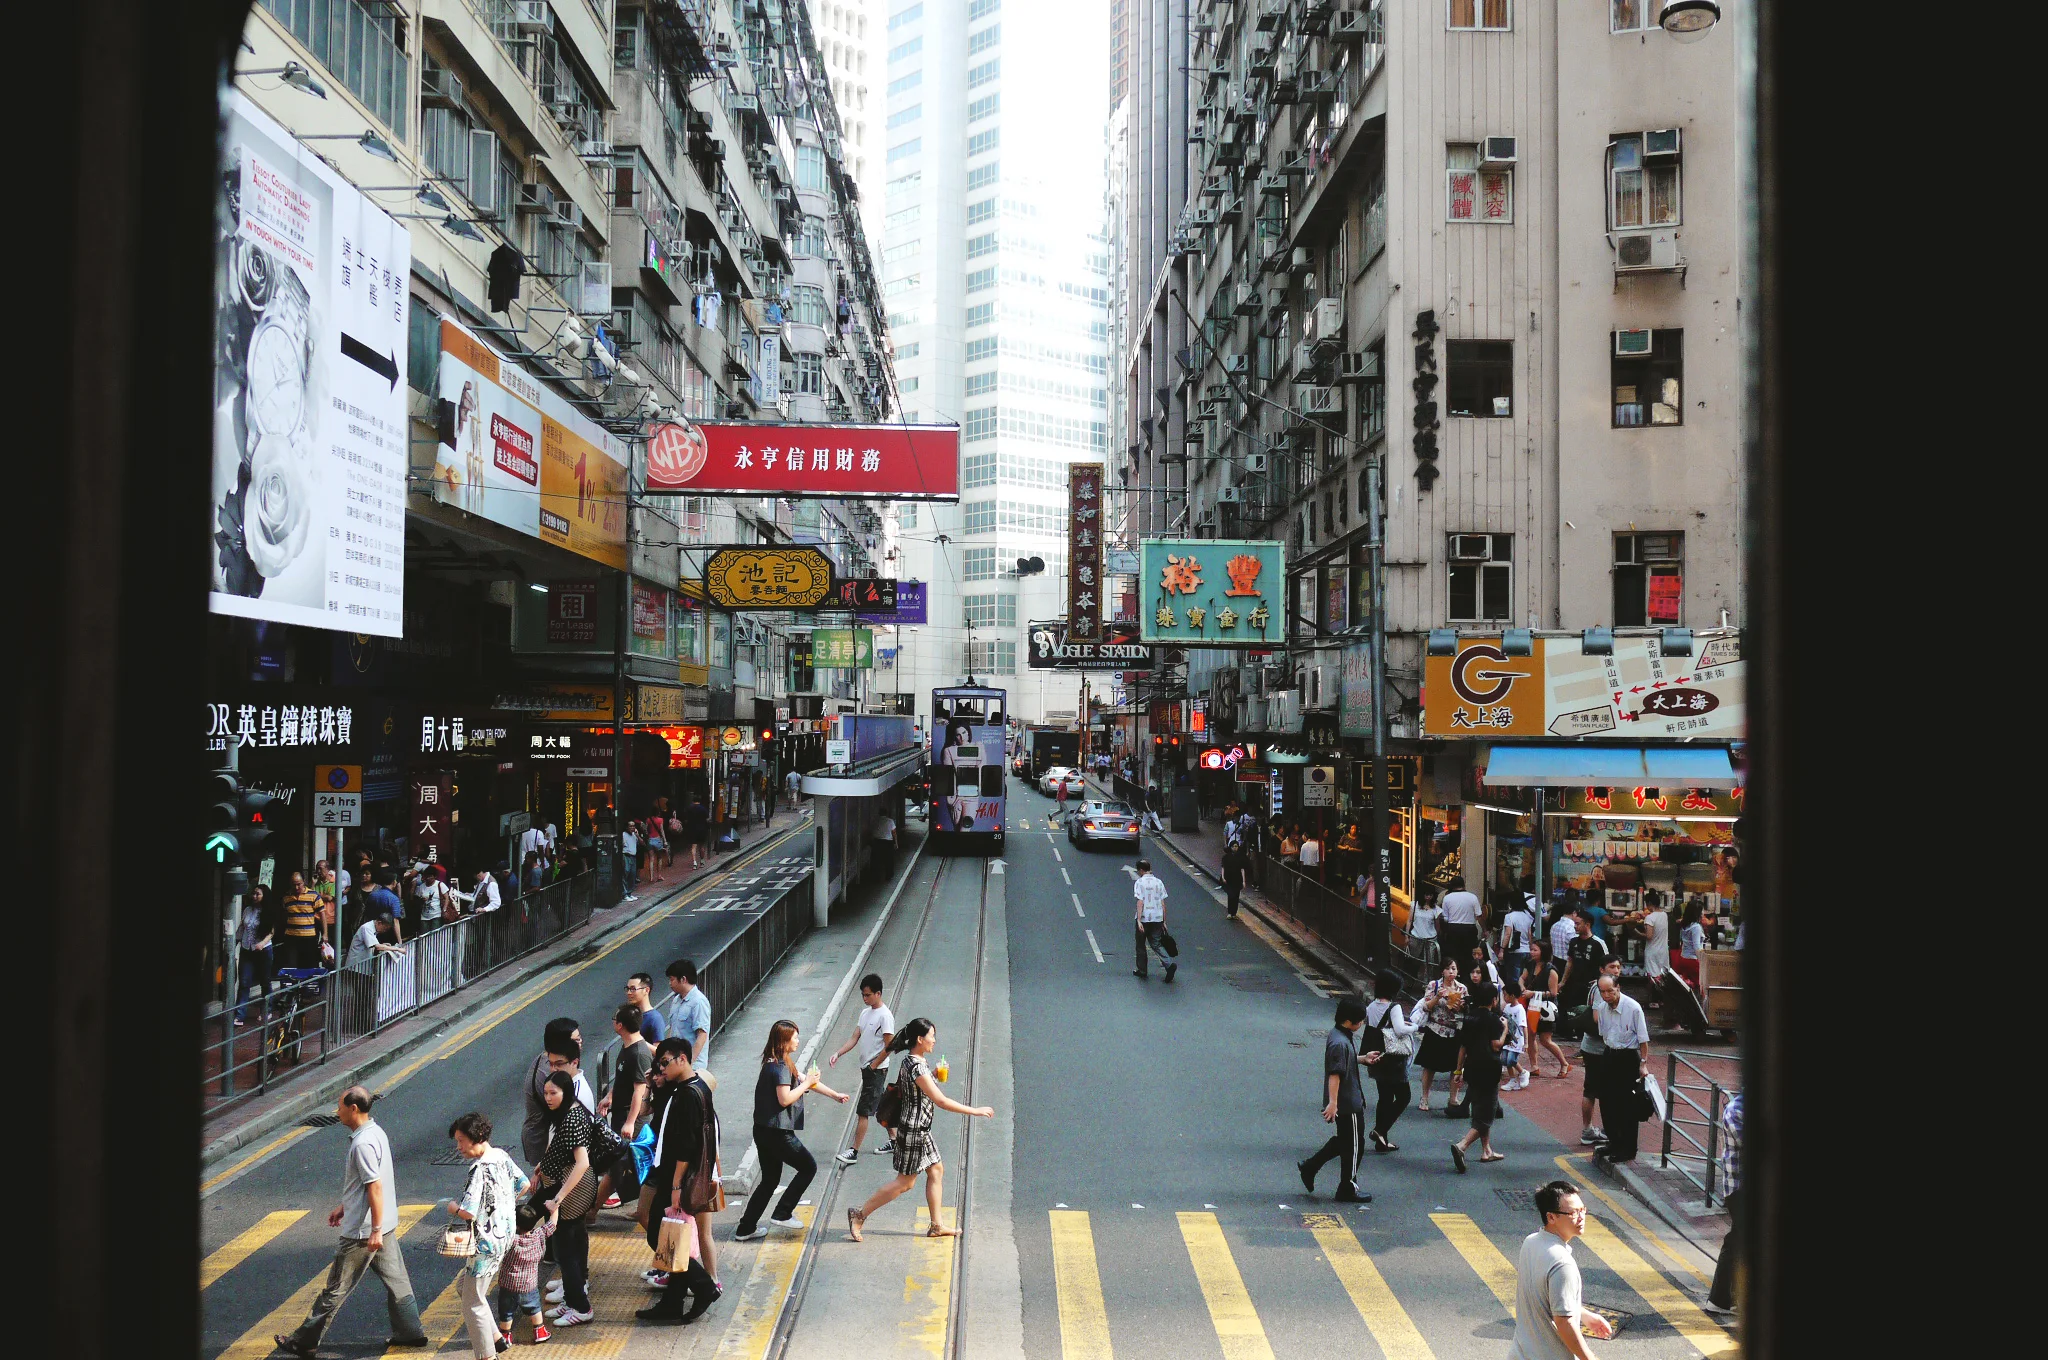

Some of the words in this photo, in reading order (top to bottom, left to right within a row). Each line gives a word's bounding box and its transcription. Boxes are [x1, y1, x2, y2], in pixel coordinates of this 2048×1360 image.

[734, 446, 881, 473] 永亨信用財務
[574, 452, 596, 524] 1%
[739, 563, 800, 583] 池記
[1160, 553, 1263, 597] 裕豐
[883, 582, 893, 606] 上海
[550, 620, 565, 629] For
[567, 620, 594, 630] Lease
[1155, 606, 1270, 630] 珠寶金行
[1047, 630, 1094, 658] VOGUE
[1099, 645, 1150, 659] STATION
[1653, 693, 1710, 710] 大上海
[237, 704, 352, 748] 英皇鐘錶珠寶
[1452, 706, 1514, 729] 大上海
[420, 716, 465, 753] 周大福
[494, 728, 507, 739] FOOK
[530, 735, 571, 748] 周大福
[319, 796, 337, 807] 24
[338, 796, 357, 808] hrs
[976, 801, 999, 818] H&M
[322, 809, 352, 824] 全日
